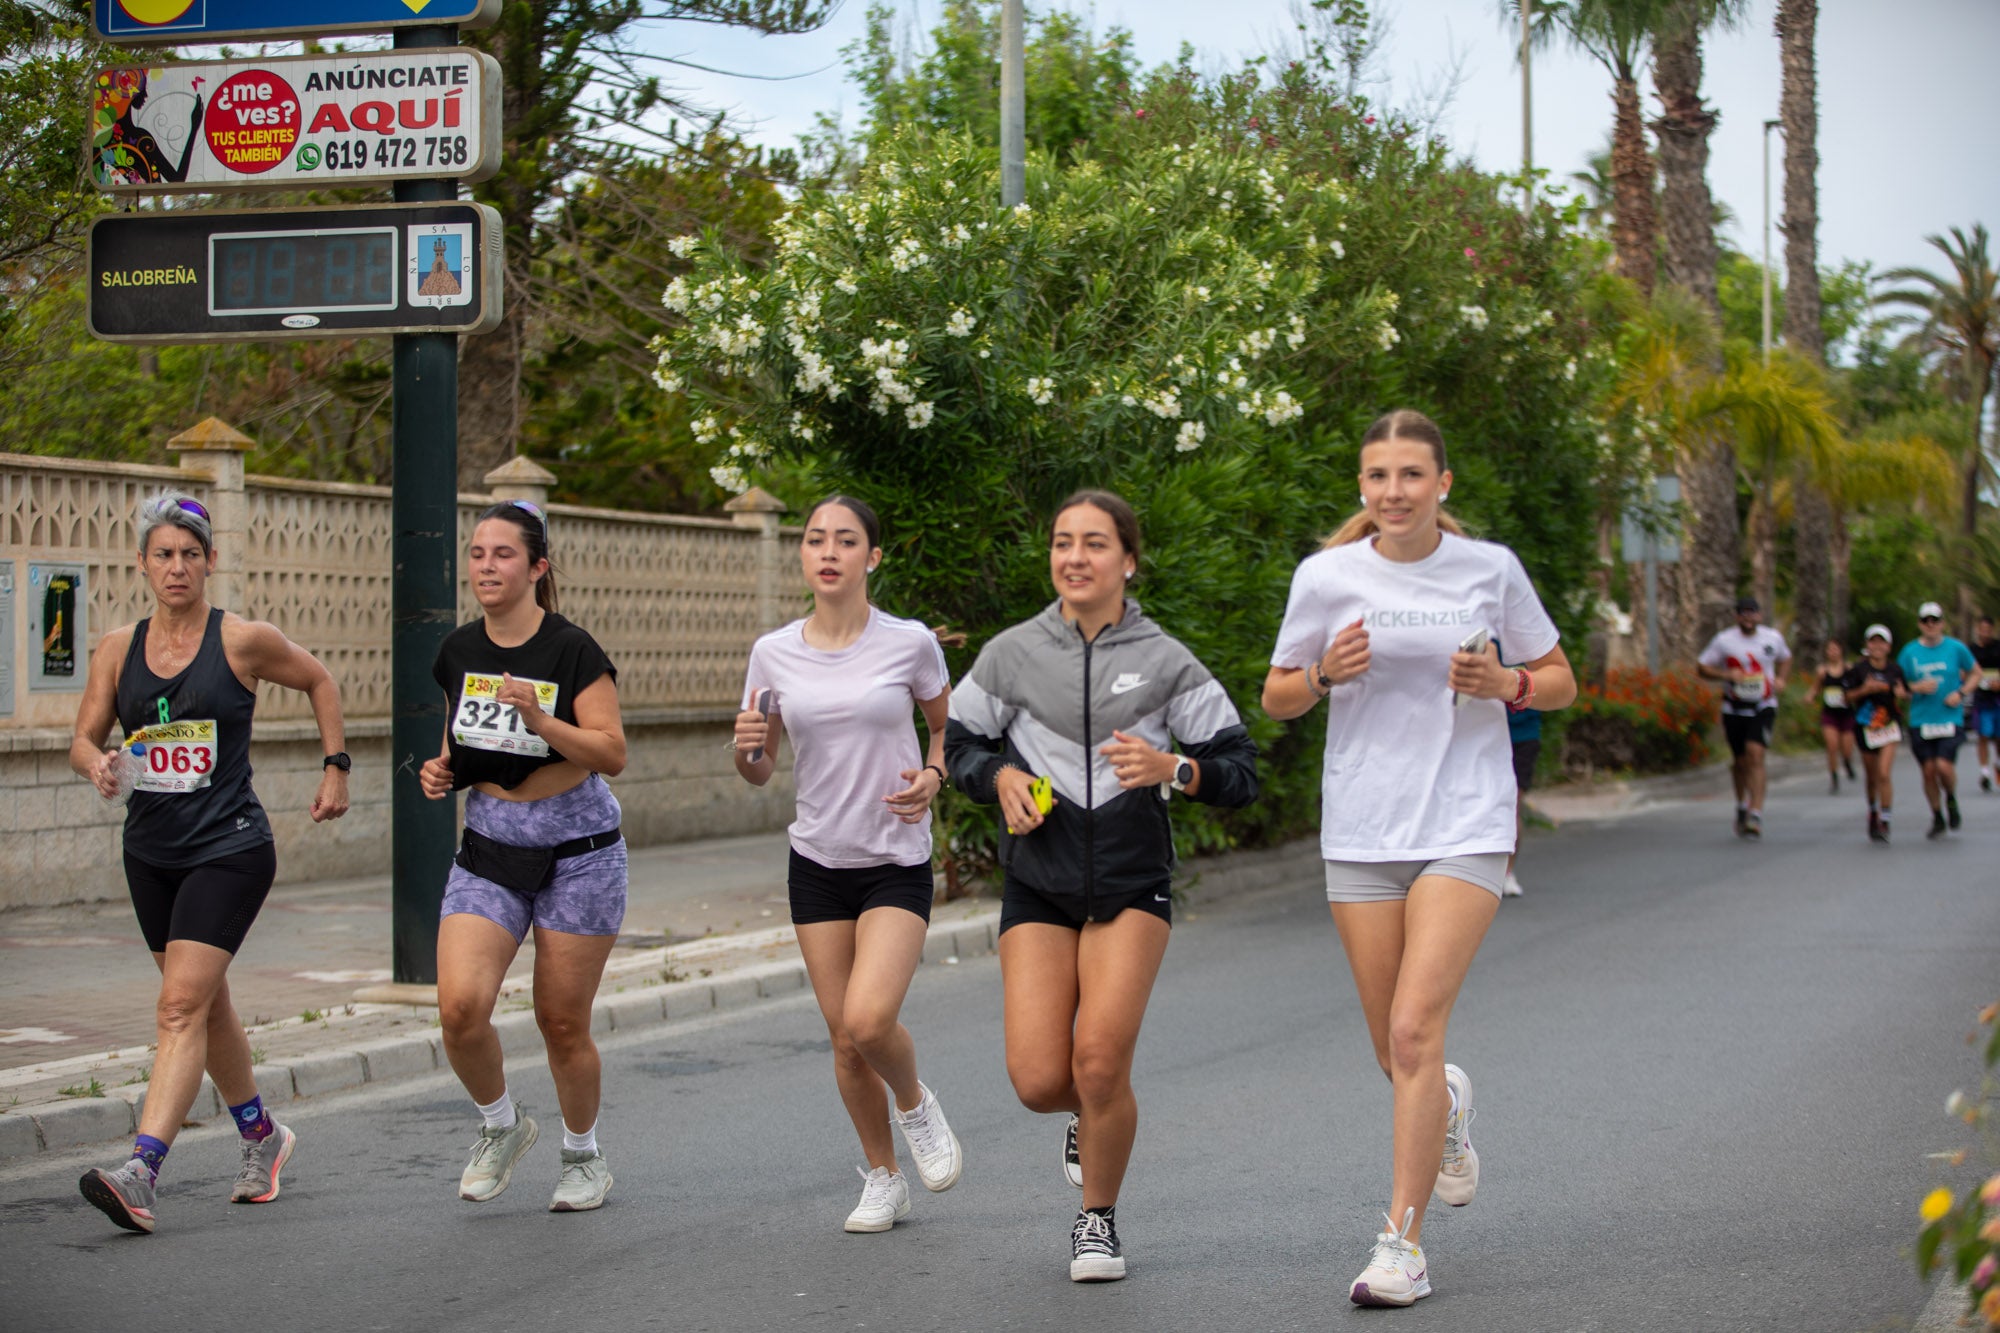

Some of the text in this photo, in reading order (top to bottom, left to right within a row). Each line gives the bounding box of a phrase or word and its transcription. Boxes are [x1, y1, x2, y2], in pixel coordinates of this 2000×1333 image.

[305, 64, 469, 92] ANÚNCIATE
[217, 83, 273, 111] ¿me
[307, 87, 464, 135] AQUÍ
[235, 100, 296, 125] ves?
[212, 128, 295, 146] TUS CLIENTES
[224, 143, 282, 163] TAMBIÉN
[325, 135, 468, 170] 619 472 758
[101, 265, 198, 288] SALOBREÑA
[475, 678, 491, 693] 38
[459, 700, 546, 736] 321
[144, 746, 212, 774] 063
